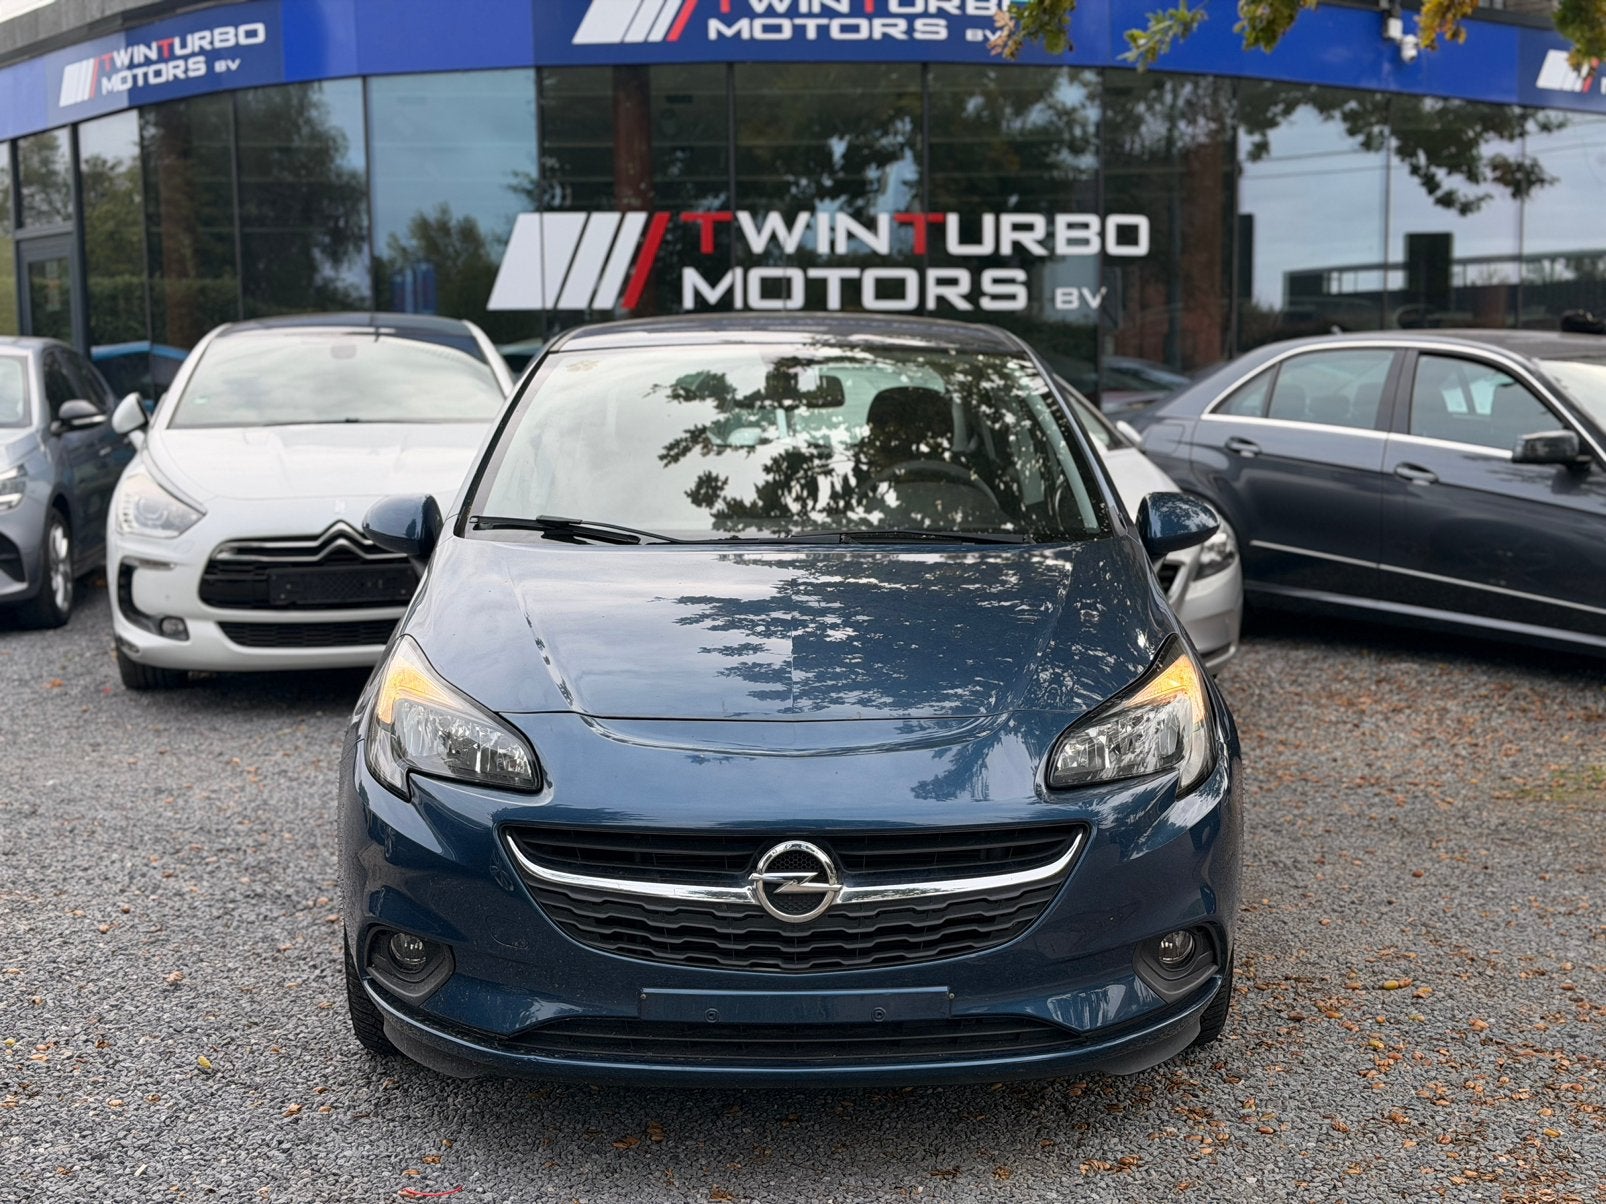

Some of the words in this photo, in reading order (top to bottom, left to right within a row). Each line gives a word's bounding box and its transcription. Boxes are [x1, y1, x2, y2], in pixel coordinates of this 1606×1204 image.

[101, 22, 267, 72] TWINTURBO
[707, 18, 948, 41] MOTORS
[101, 55, 207, 96] MOTORS
[214, 58, 241, 73] BV
[680, 210, 1151, 257] TWINTURBO
[682, 266, 1029, 311] MOTORS
[1054, 286, 1108, 310] BV
